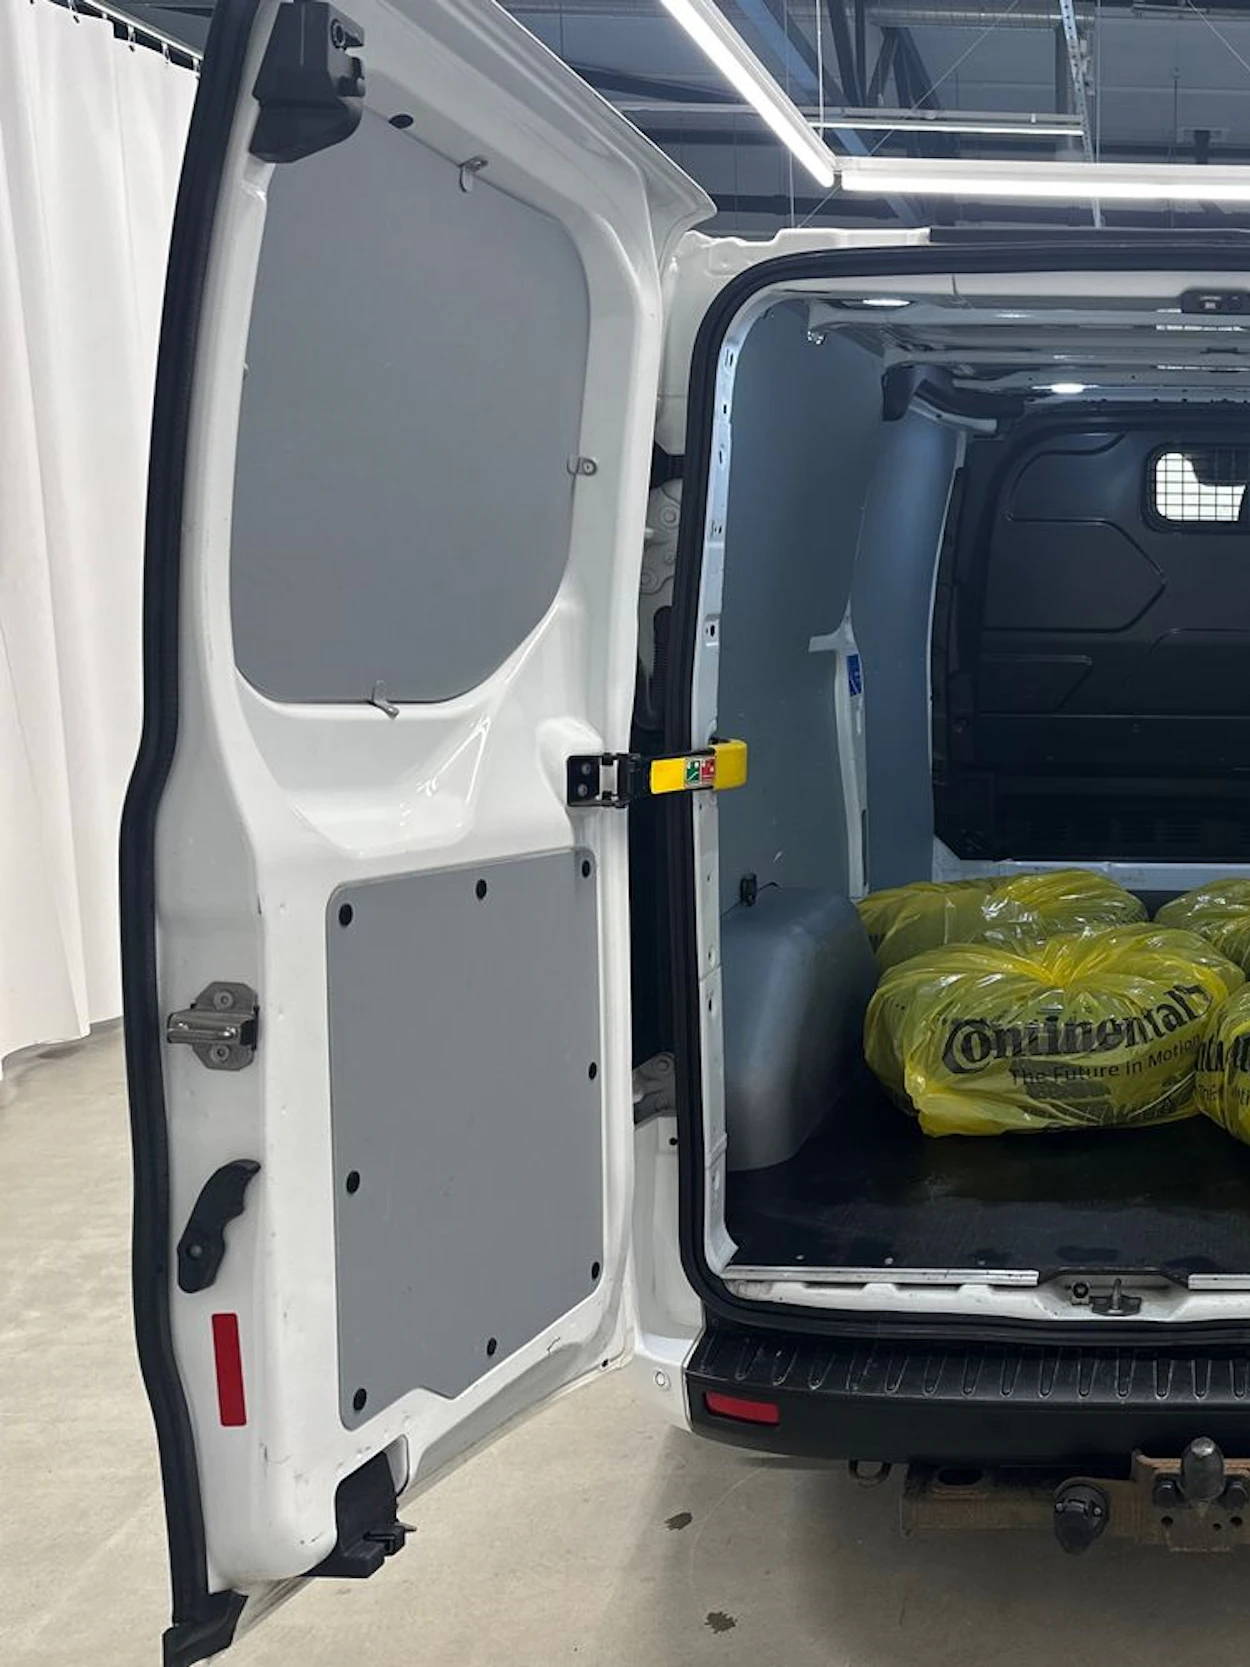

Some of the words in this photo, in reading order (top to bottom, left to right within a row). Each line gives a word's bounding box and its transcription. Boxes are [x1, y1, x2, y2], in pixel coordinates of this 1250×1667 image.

[942, 984, 1213, 1074] Continental
[1009, 1065, 1045, 1086] The
[1054, 1063, 1120, 1083] Future
[1126, 1060, 1143, 1076] in
[1147, 1033, 1200, 1068] Motion
